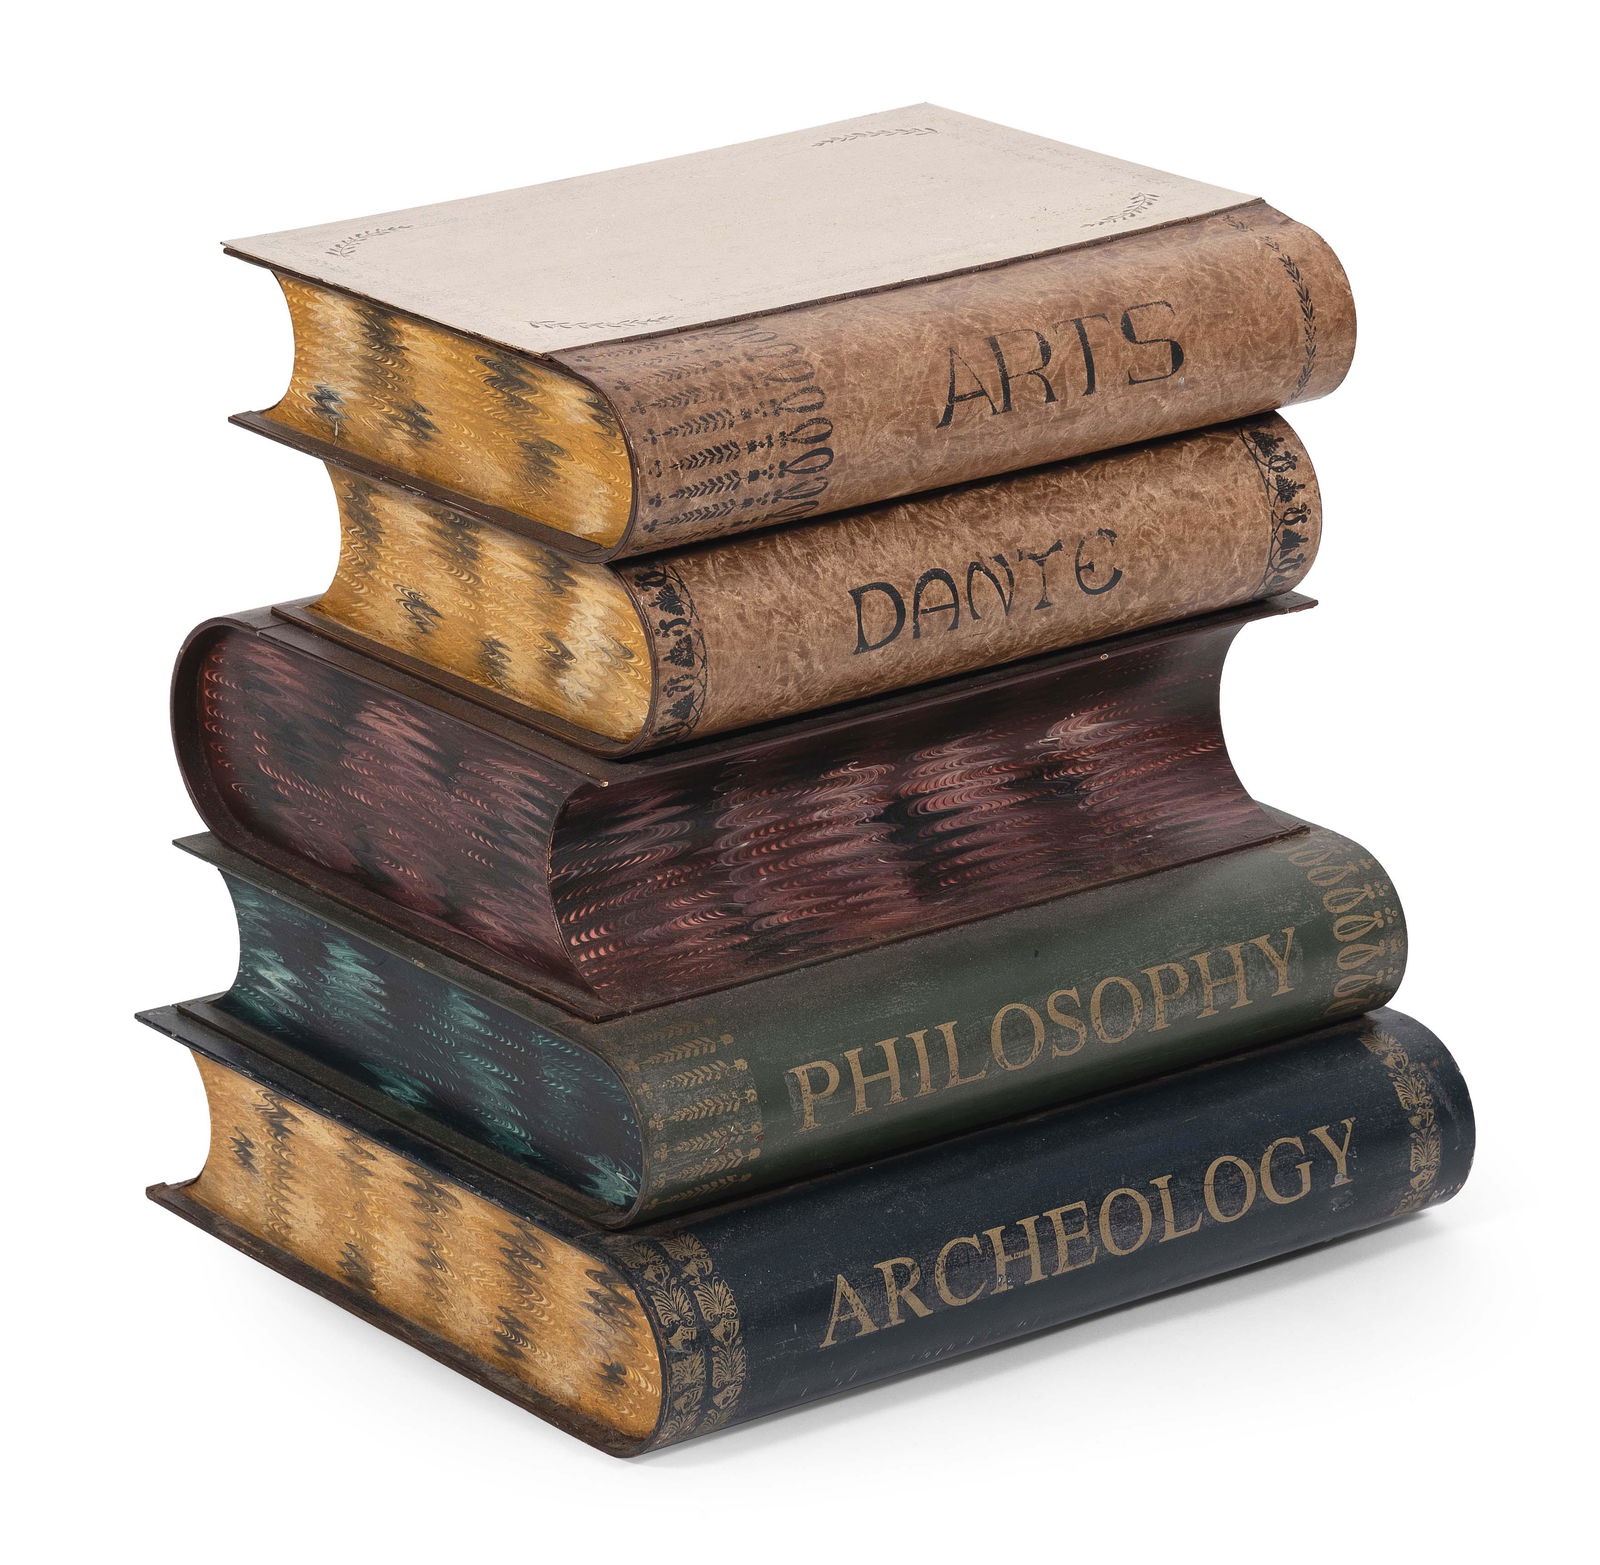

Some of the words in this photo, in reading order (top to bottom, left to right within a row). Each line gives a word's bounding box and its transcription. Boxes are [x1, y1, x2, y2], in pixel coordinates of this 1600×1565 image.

[936, 300, 1184, 428] ARTS
[848, 528, 1123, 655] DANTE
[788, 926, 1297, 1133] PHILOSOPHY
[819, 1117, 1357, 1348] ARCHEOLOGY
